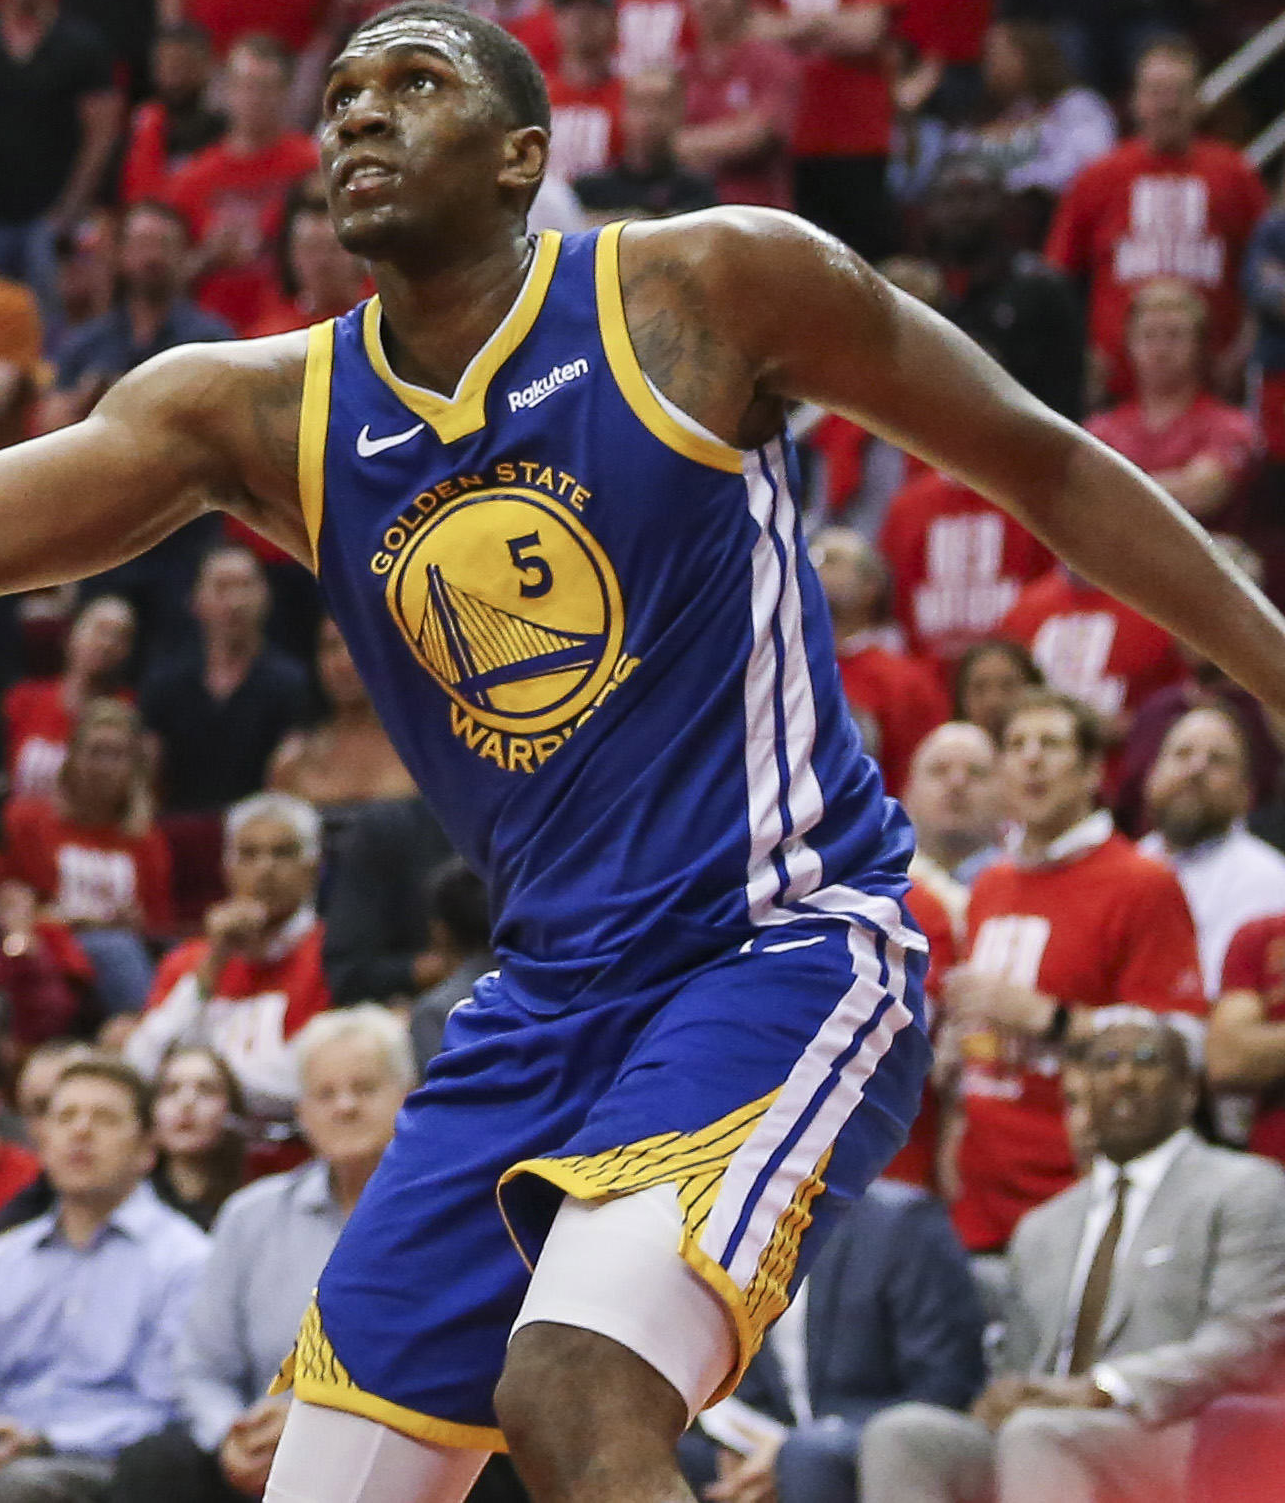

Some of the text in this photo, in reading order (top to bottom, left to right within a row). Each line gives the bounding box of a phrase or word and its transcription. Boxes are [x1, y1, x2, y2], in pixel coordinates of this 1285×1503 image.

[507, 357, 590, 414] Rakuten
[369, 461, 592, 577] GOLDEN STATE
[504, 530, 554, 599] 5
